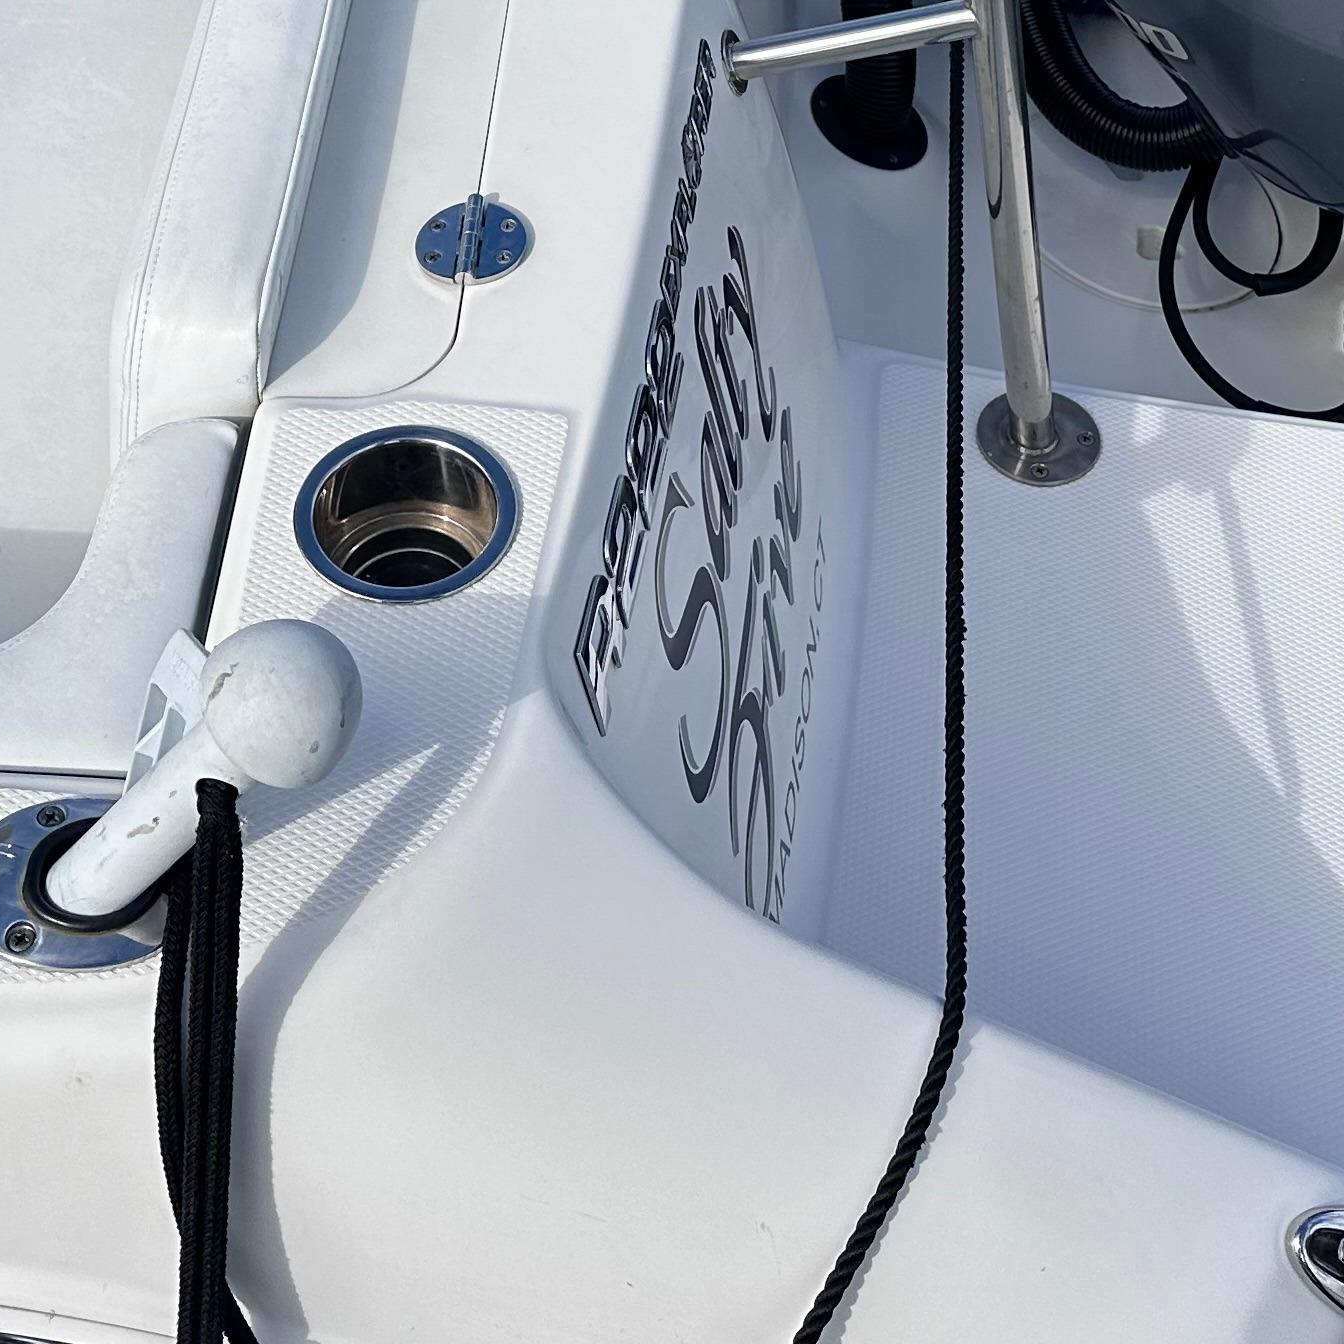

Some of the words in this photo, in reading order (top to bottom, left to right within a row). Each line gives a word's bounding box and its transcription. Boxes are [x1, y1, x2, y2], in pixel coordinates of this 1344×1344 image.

[654, 225, 777, 805] Salty
[729, 405, 803, 917] Five
[814, 513, 826, 613] CT
